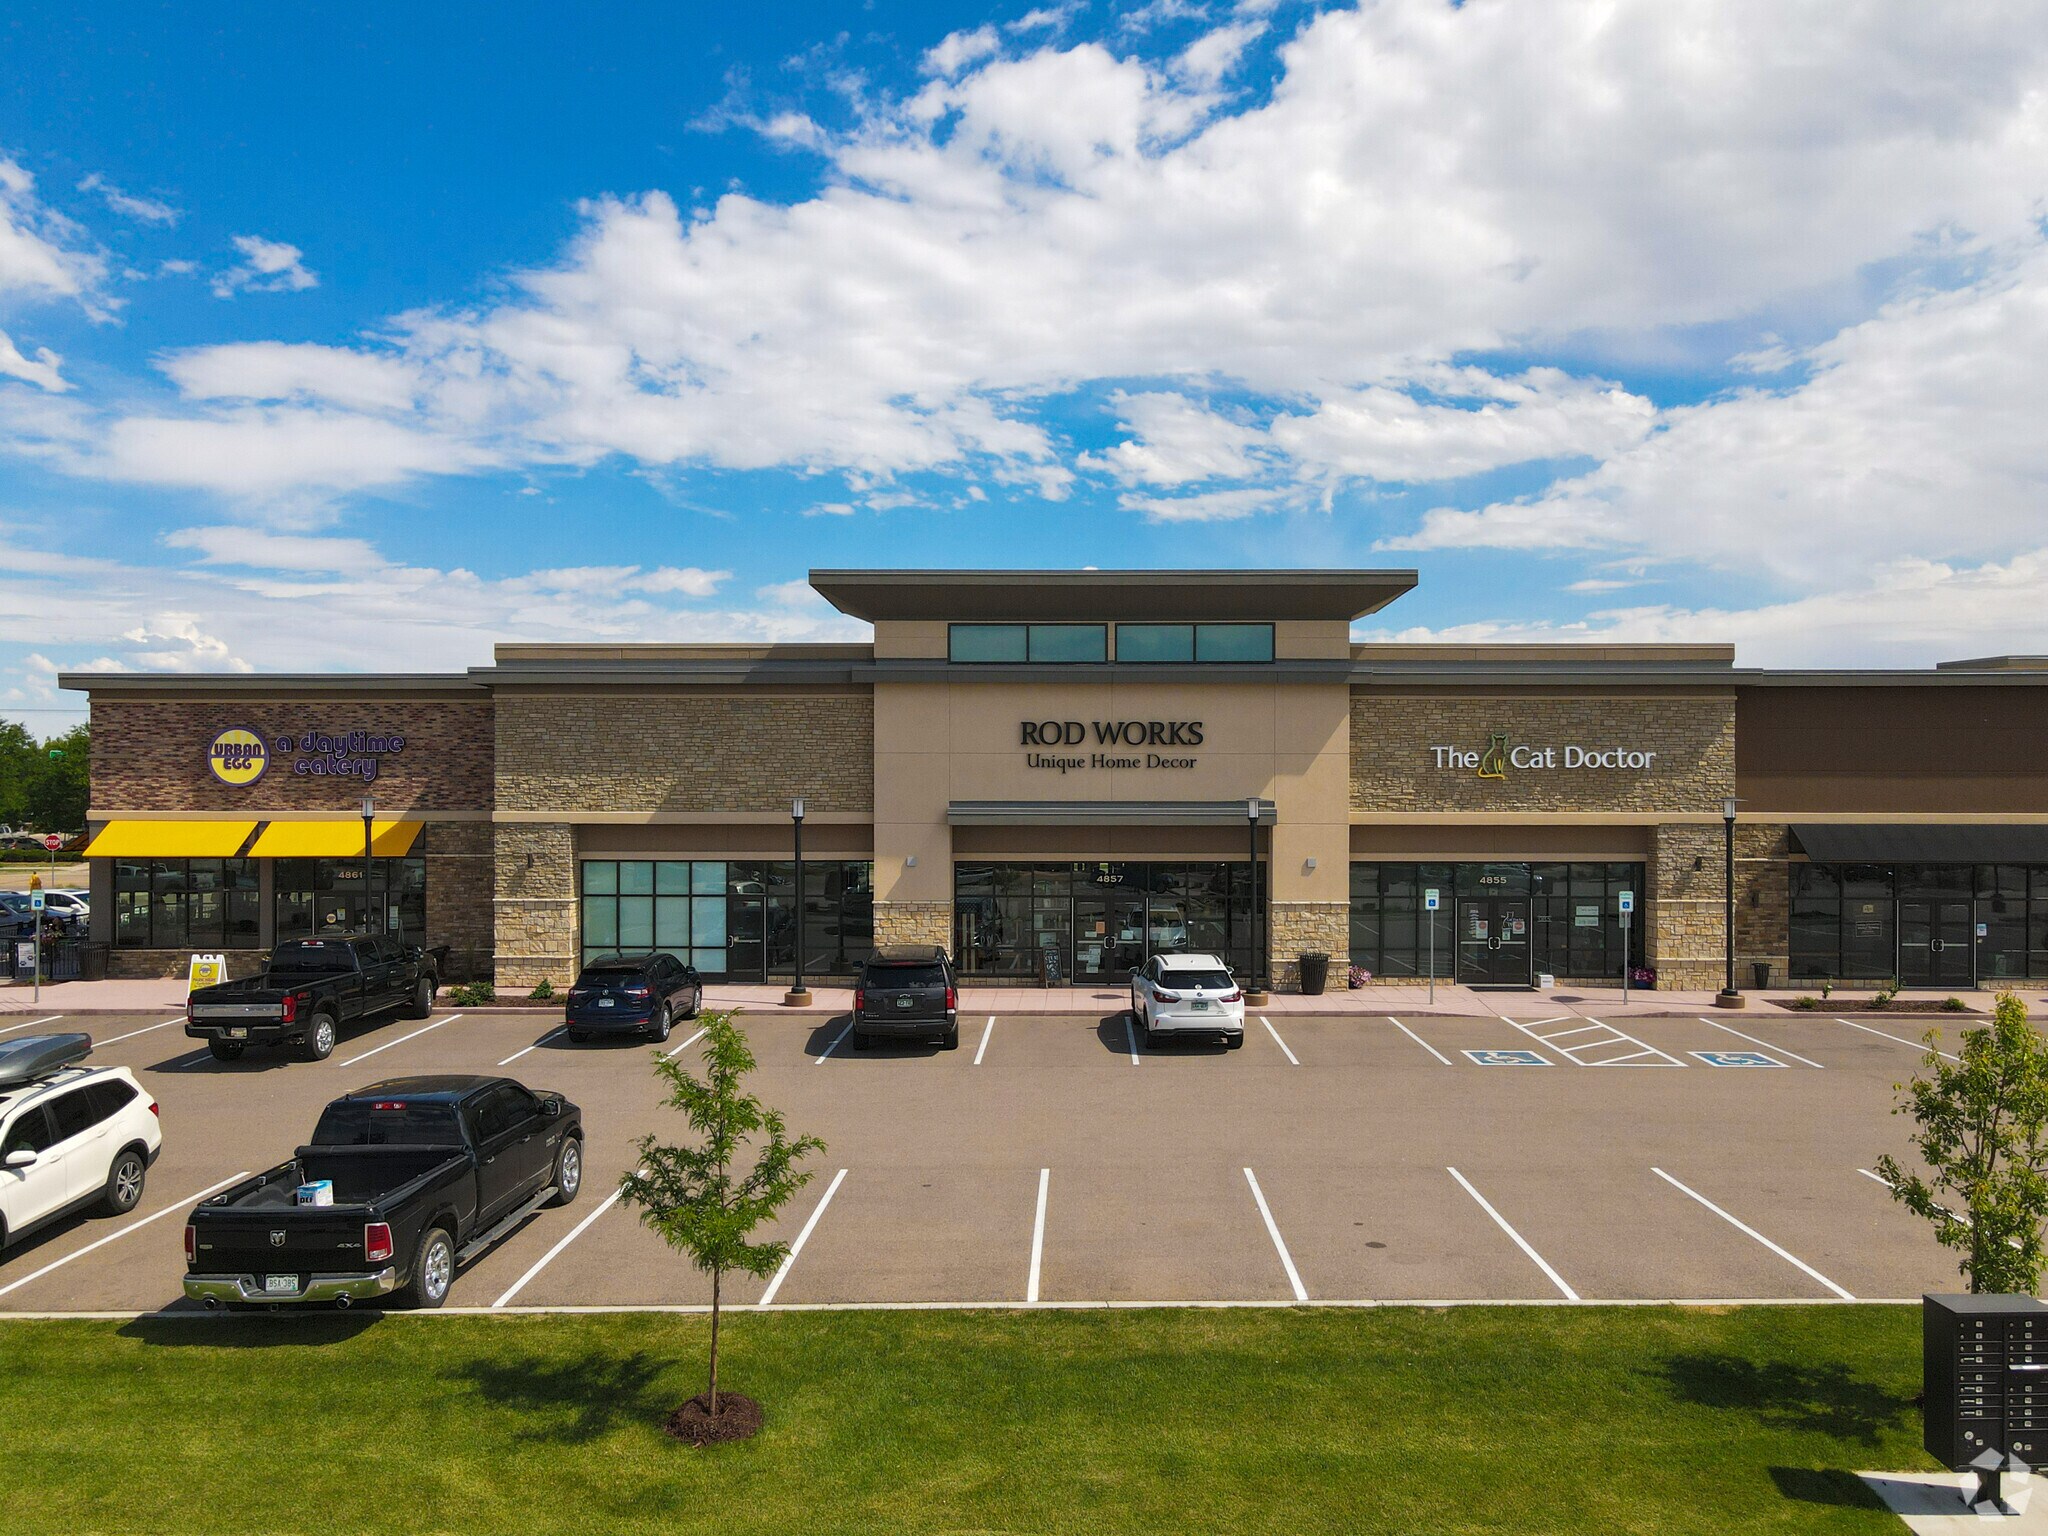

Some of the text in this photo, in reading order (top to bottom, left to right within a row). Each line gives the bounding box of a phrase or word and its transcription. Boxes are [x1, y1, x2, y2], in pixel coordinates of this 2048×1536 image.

[1020, 721, 1204, 746] ROD WORKS
[213, 743, 262, 757] URBAN
[275, 731, 405, 759] a daytime
[223, 758, 252, 770] EGG
[1027, 753, 1197, 774] Unique Home Decor
[1430, 745, 1657, 770] The Cat Doctor
[294, 754, 378, 782] eatery
[45, 839, 60, 847] STOP
[338, 871, 363, 879] 4861
[1096, 875, 1124, 883] 4857
[1479, 876, 1507, 884] 4855
